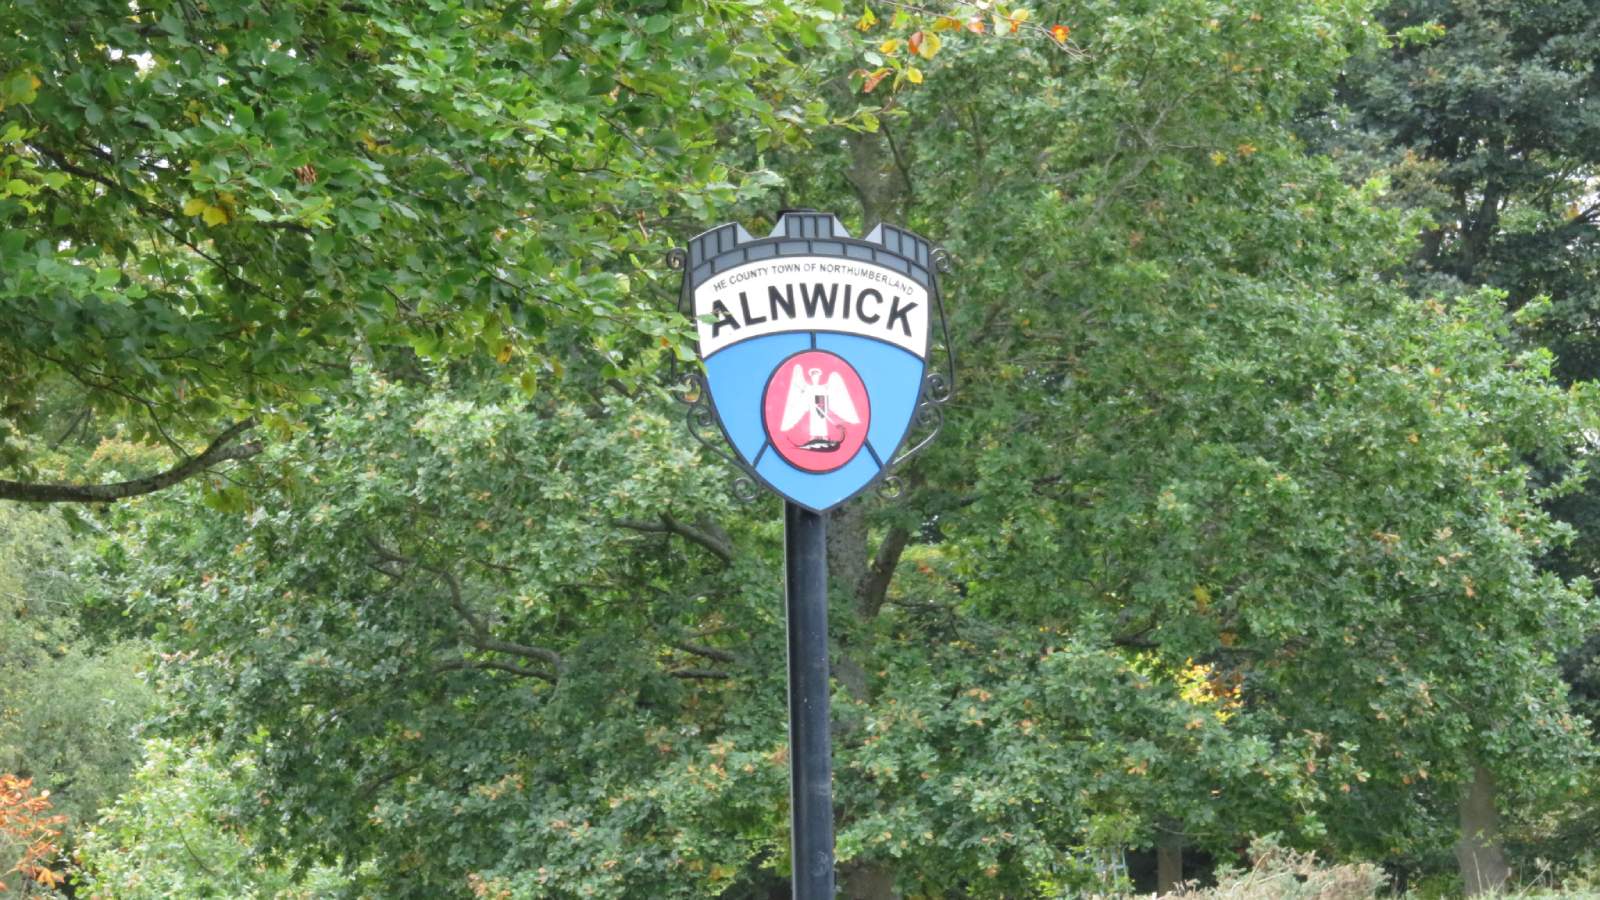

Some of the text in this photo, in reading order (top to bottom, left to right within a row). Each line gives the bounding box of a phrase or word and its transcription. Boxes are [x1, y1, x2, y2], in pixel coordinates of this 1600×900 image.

[730, 267, 769, 285] COUNTY
[771, 263, 801, 274] TOWN
[803, 263, 817, 272] OF
[820, 263, 914, 296] NORTHUMBERLAND
[712, 282, 919, 338] ALNWICK
